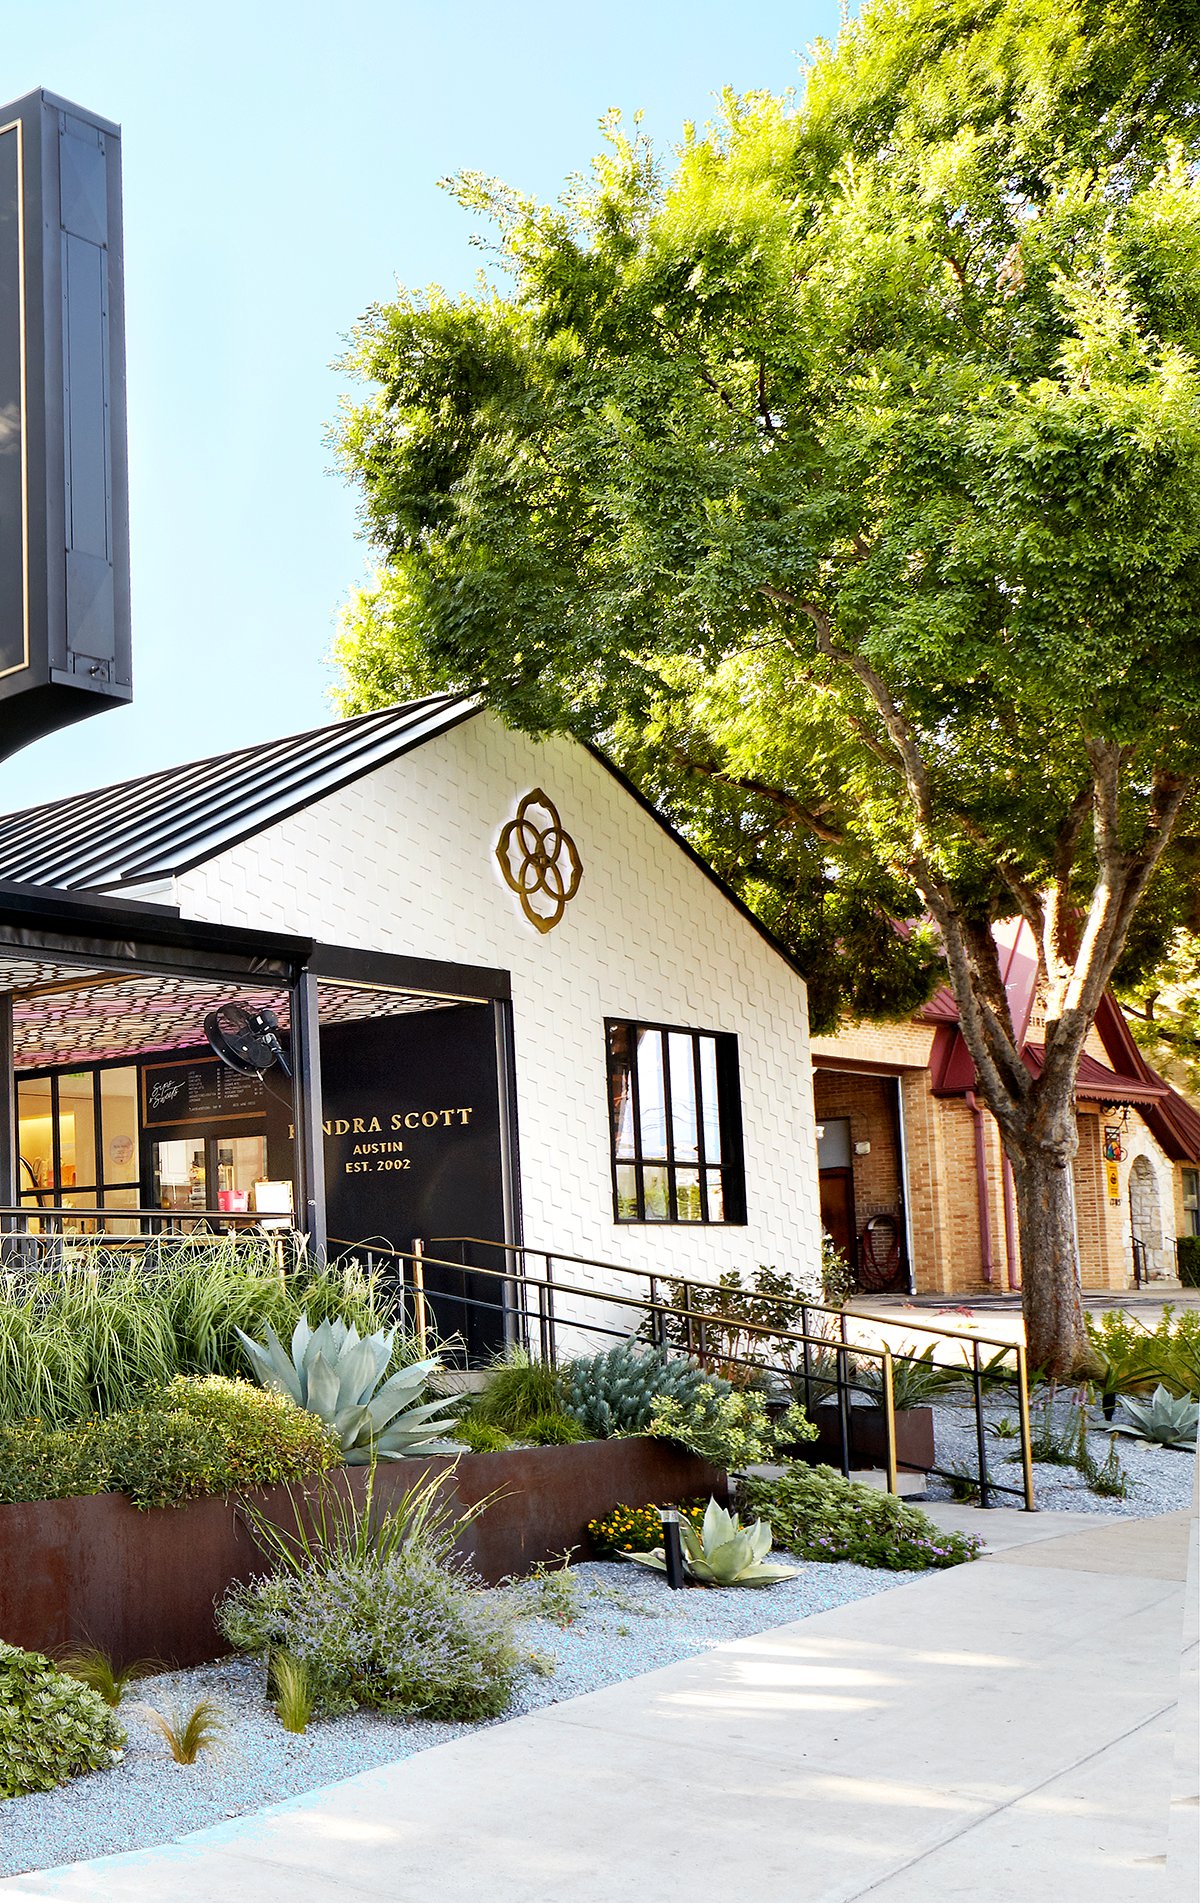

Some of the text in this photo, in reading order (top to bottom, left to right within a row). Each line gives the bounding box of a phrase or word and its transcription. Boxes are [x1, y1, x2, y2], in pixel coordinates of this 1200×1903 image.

[288, 1107, 473, 1140] NDRA SCOTT
[353, 1141, 403, 1155] AUSTIN
[345, 1158, 411, 1173] EST. 2002
